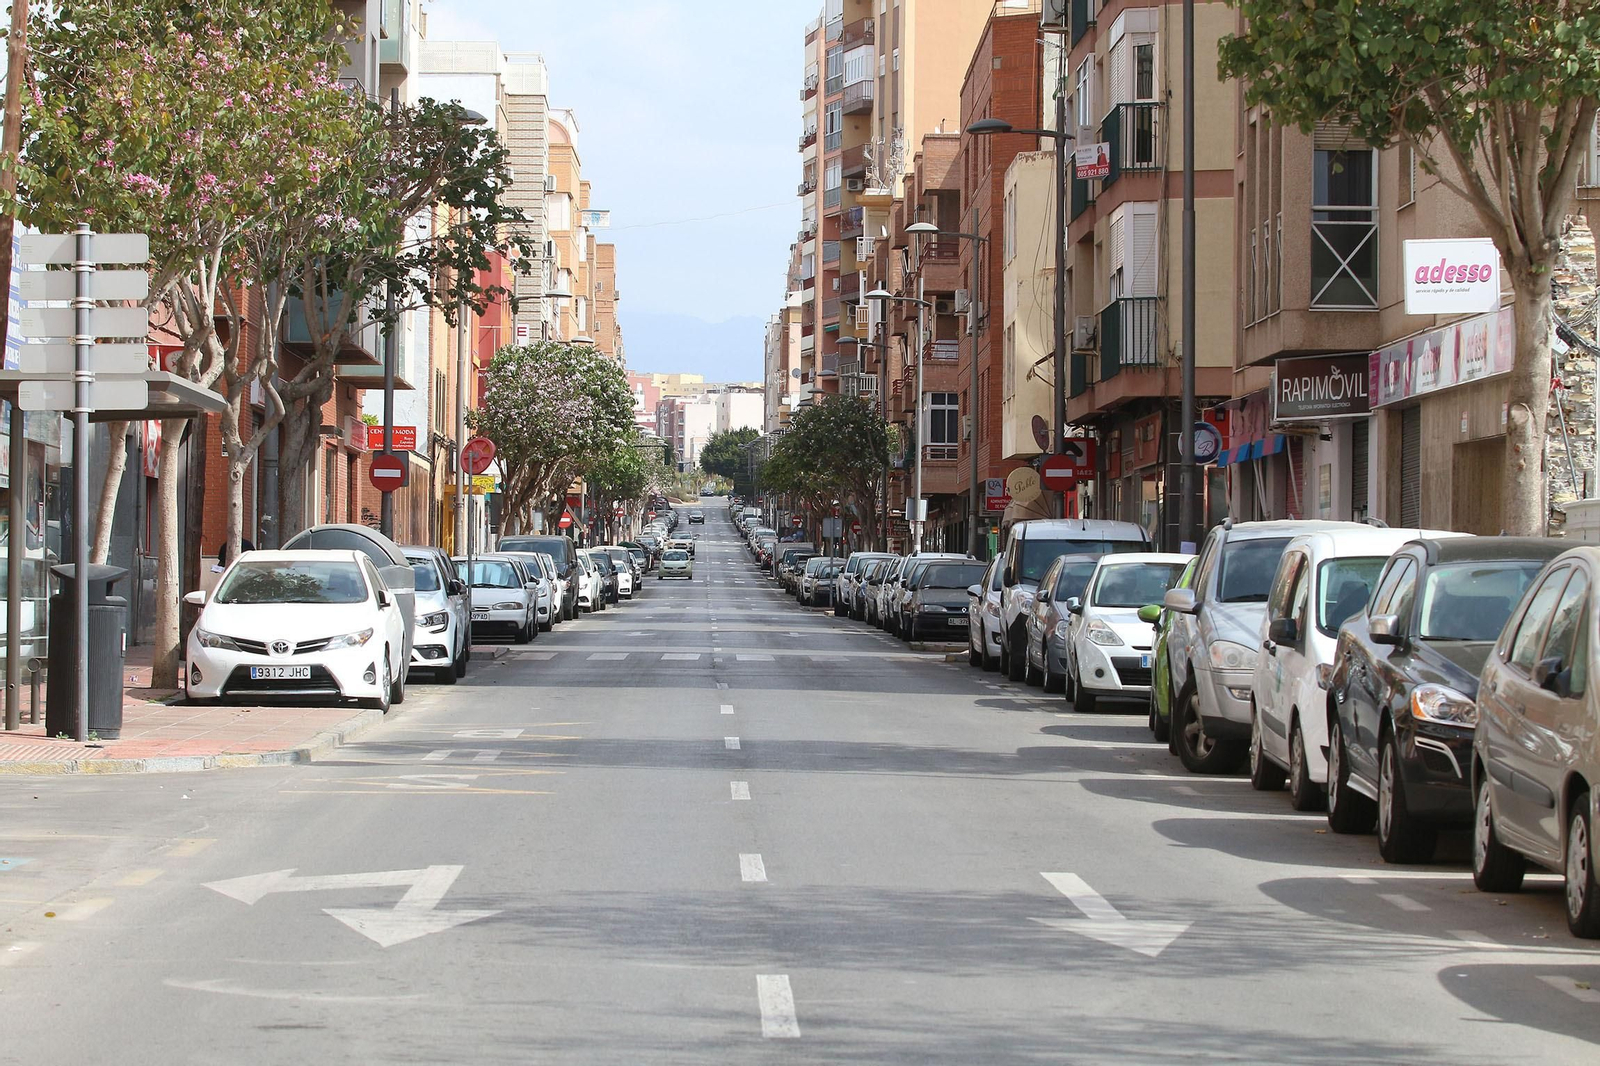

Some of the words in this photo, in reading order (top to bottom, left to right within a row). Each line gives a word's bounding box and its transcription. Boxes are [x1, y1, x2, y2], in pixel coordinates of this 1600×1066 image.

[1415, 258, 1492, 284] adesso
[257, 667, 285, 678] 9312
[288, 667, 309, 678] JHC
